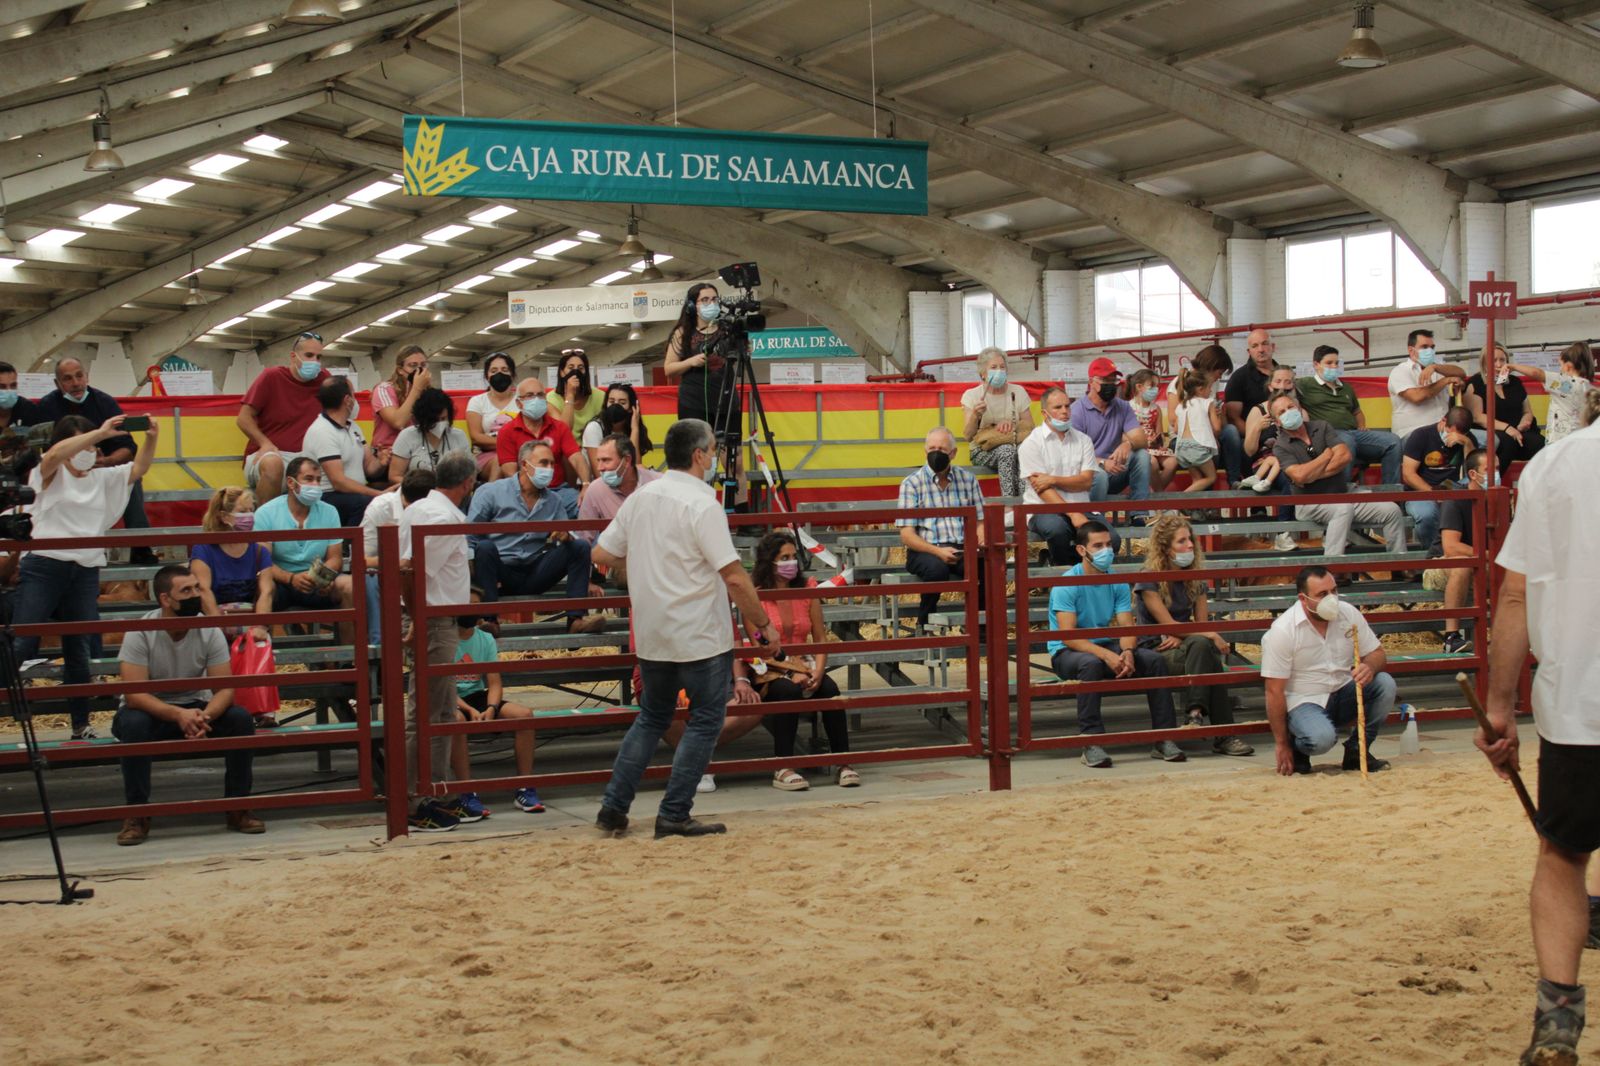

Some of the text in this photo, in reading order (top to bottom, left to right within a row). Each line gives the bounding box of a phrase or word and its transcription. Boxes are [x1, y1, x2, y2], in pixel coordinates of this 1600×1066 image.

[485, 145, 916, 190] CAJA RURAL DE SALAMANCA
[1476, 291, 1512, 308] 1077
[528, 303, 573, 316] Diputación
[586, 301, 629, 312] Salamanca
[767, 336, 808, 350] RURAL
[810, 335, 827, 348] DE
